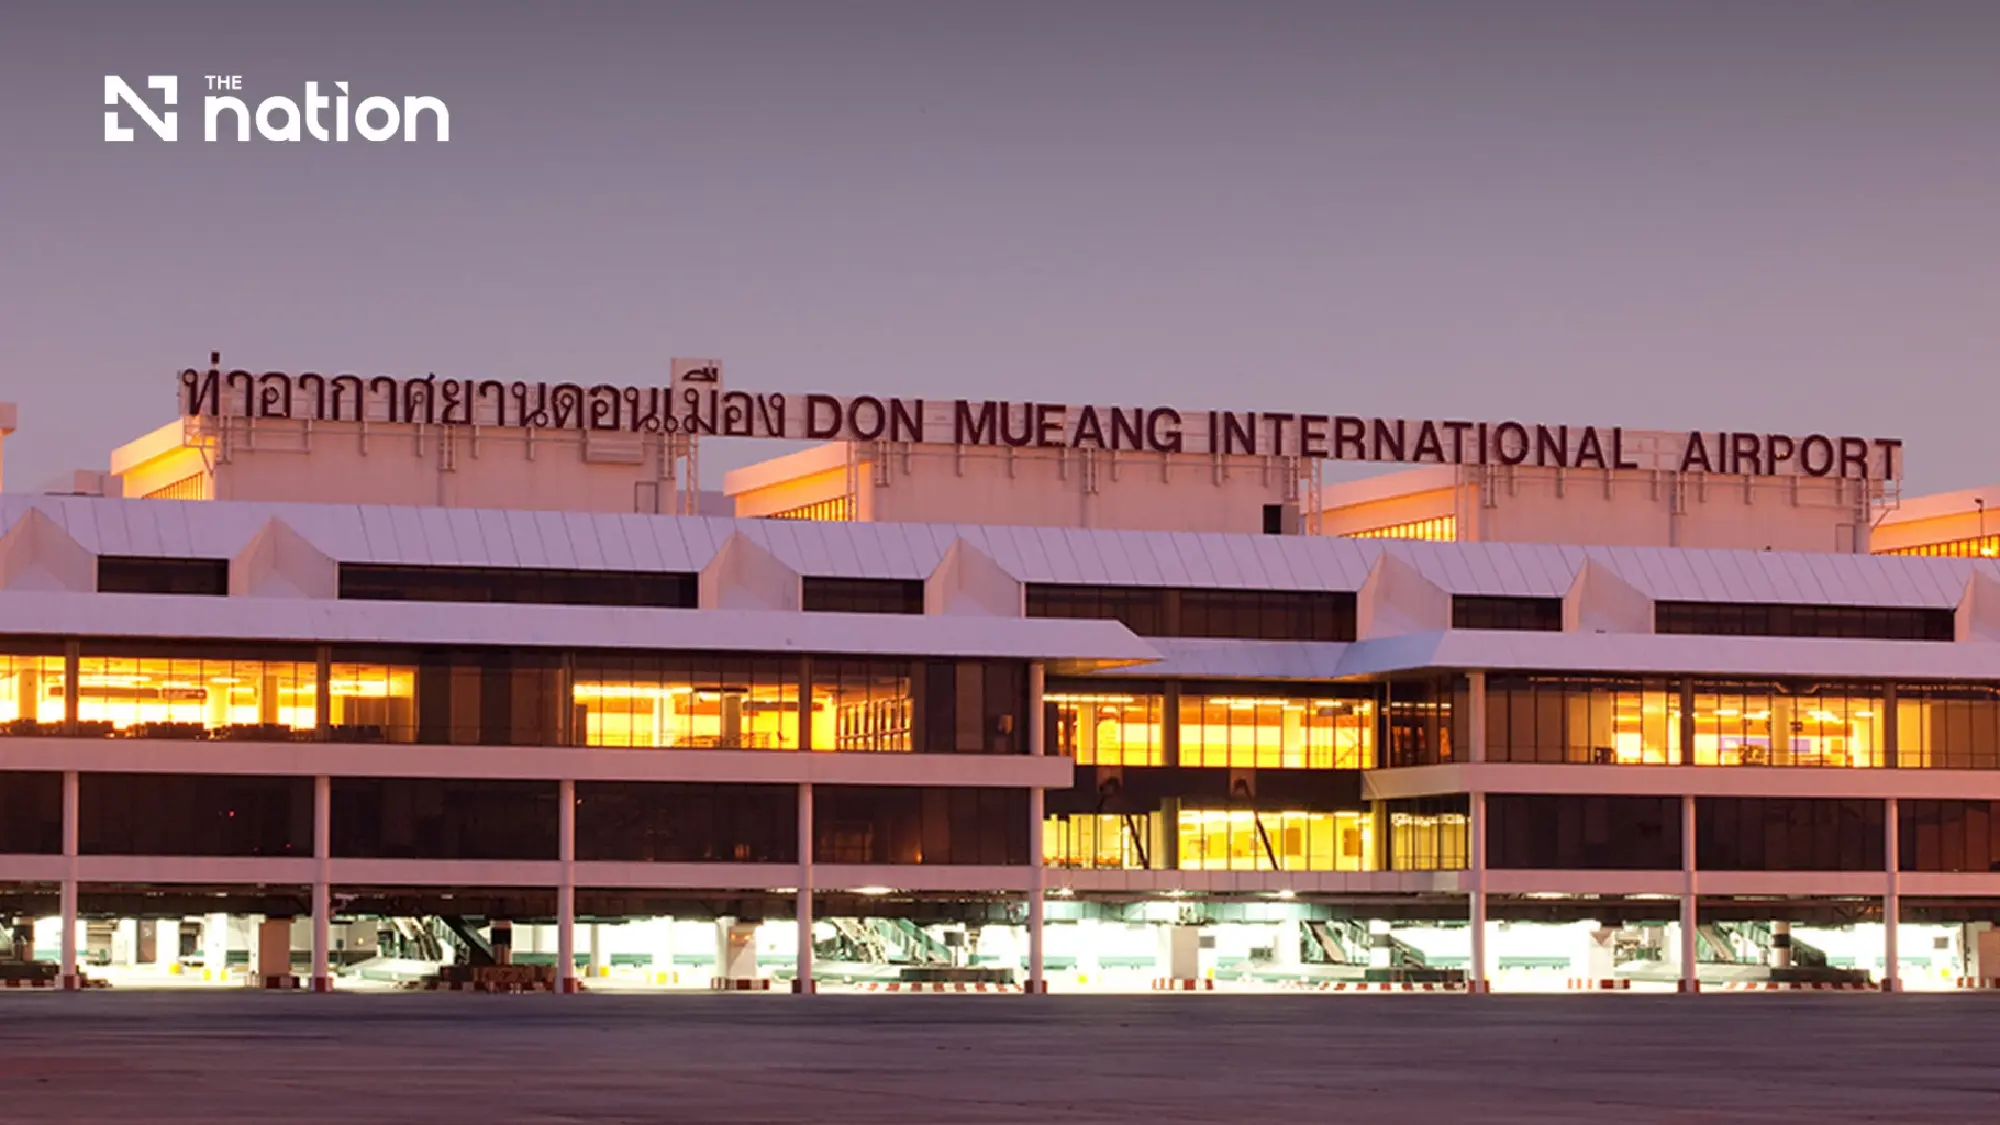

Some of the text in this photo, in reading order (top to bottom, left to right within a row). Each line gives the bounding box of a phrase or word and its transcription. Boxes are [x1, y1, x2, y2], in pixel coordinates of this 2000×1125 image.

[181, 352, 786, 437] ท่าอากาศยานดอนเมือง
[806, 394, 1902, 481] DON MUEANG INTERNATIONAL AIRPORT
